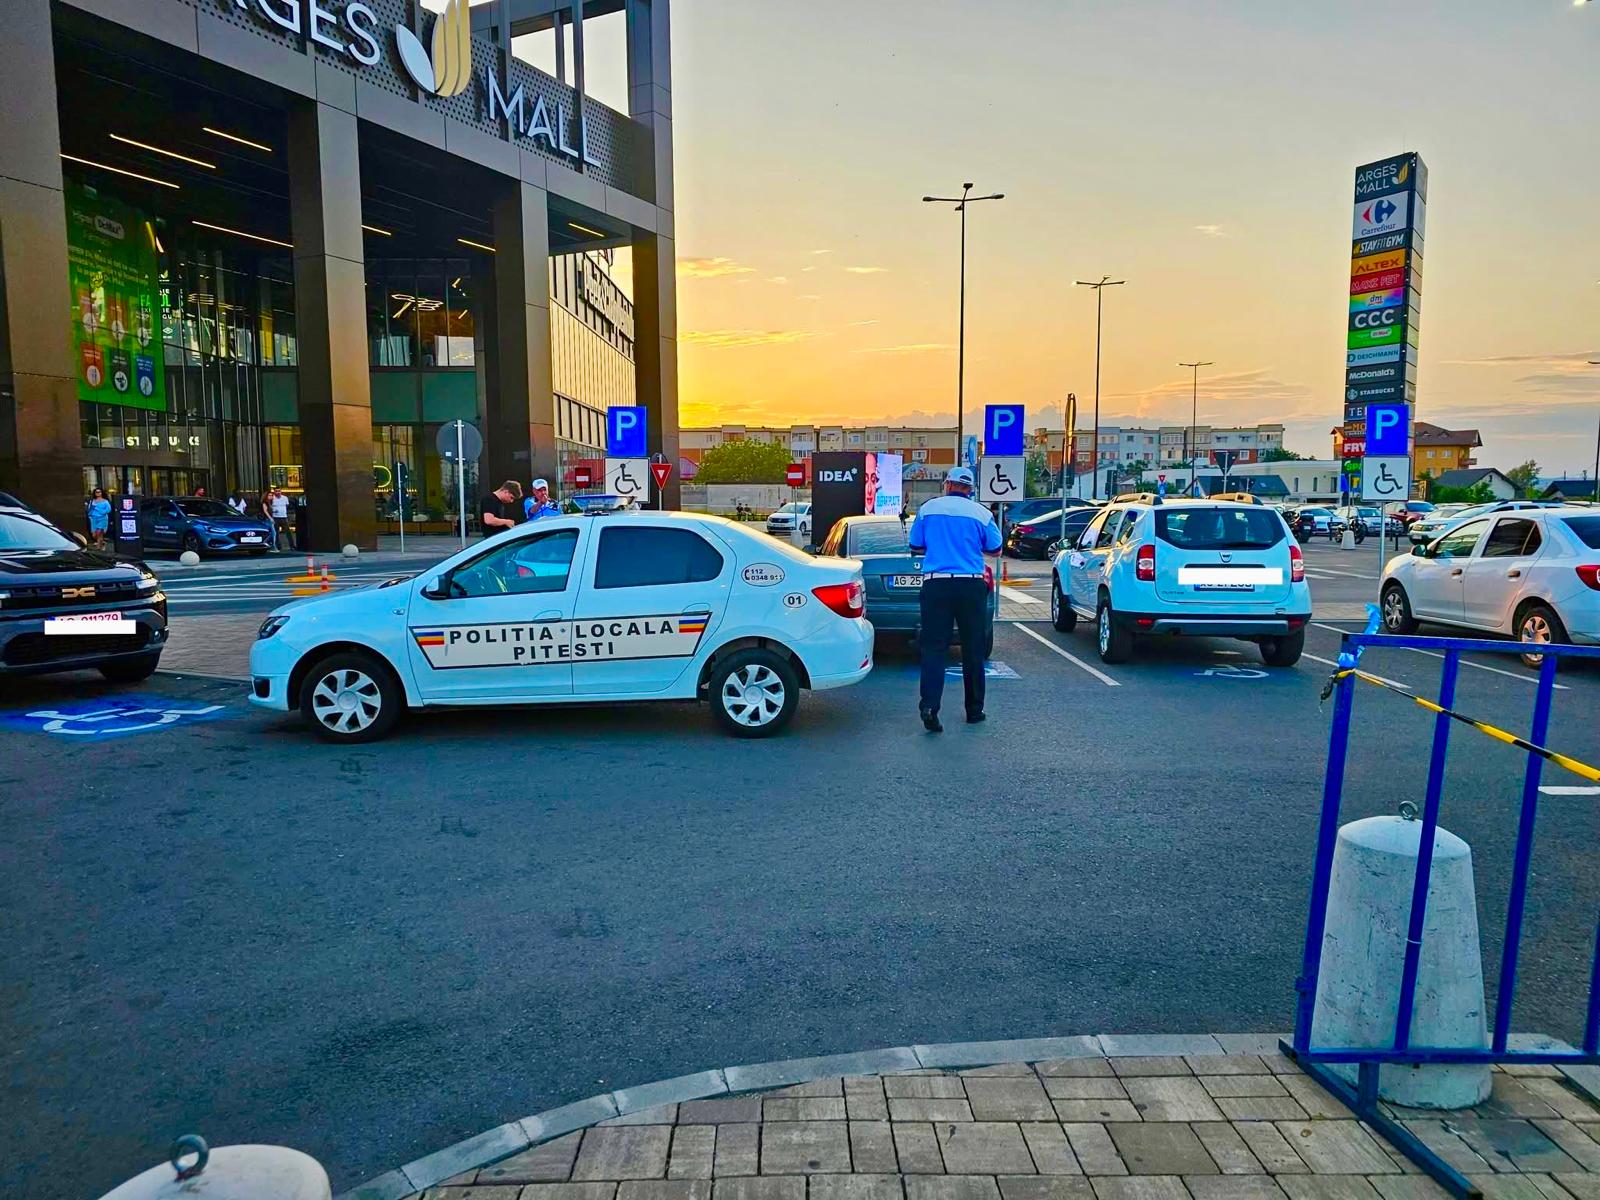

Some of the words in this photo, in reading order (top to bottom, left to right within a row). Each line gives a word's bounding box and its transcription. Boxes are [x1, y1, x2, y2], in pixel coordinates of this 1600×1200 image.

[487, 65, 602, 169] MALL
[1356, 163, 1398, 185] ARGES
[1355, 179, 1390, 196] MALL
[1361, 223, 1397, 236] Carrefour
[1360, 234, 1405, 253] STAYFITGYM
[1355, 258, 1400, 274] ALTEX
[1354, 308, 1395, 329] CCC
[1357, 350, 1399, 360] DEICHMANN
[1349, 368, 1395, 380] McDonald's
[1360, 387, 1395, 396] STARBUCKS
[616, 411, 637, 441] P
[993, 409, 1016, 440] P
[1375, 409, 1399, 440] P
[894, 576, 907, 586] AG
[787, 595, 802, 606] 01
[449, 626, 554, 645] POLITIA
[575, 620, 674, 639] LOCALA
[513, 641, 614, 660] PITESTI
